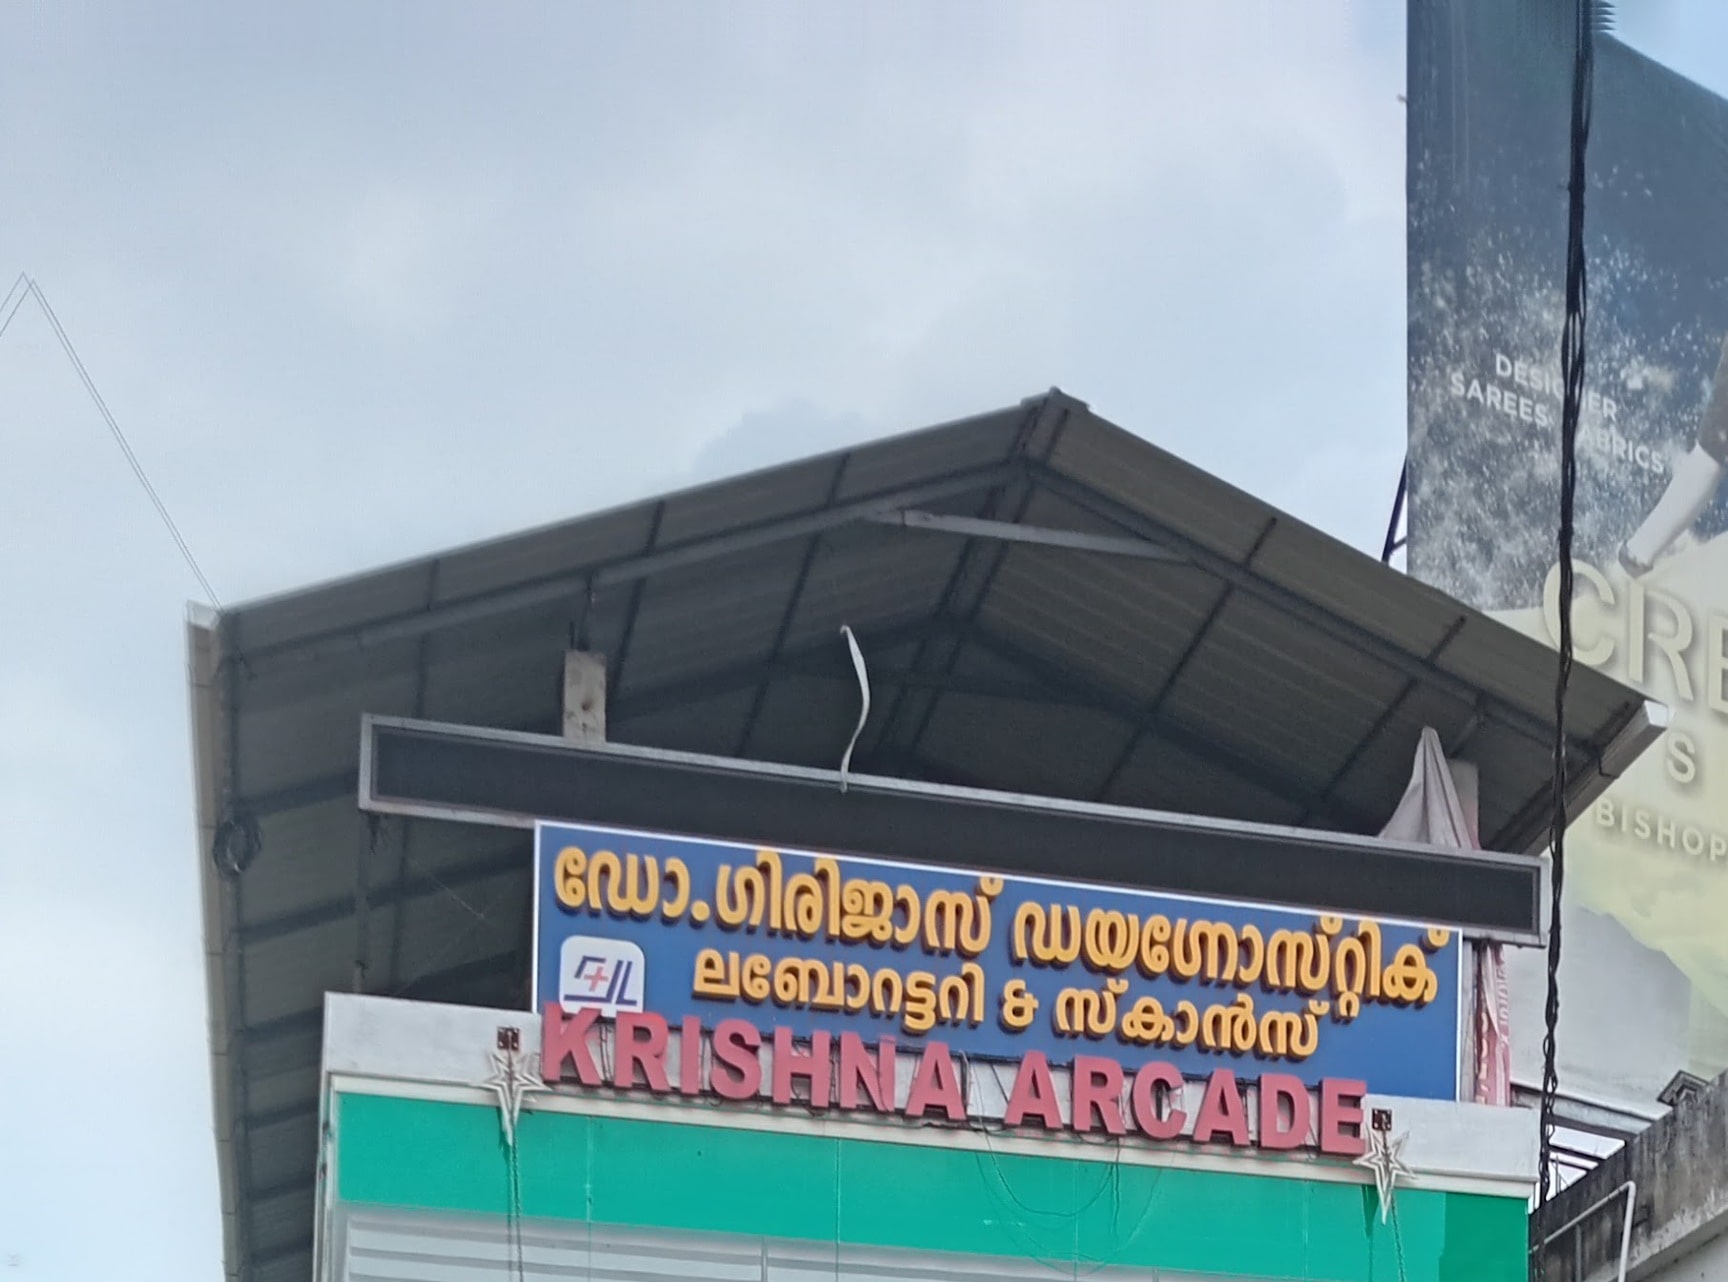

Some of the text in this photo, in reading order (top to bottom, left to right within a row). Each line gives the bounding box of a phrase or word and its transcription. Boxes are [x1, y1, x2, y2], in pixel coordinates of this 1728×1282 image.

[1450, 371, 1664, 475] SAREES ABRICS
[1595, 798, 1728, 863] BISHOP
[693, 948, 1329, 1058] ലബോറട്ടറി & സ്കാൻസ്
[540, 1003, 969, 1124] KRISHNA
[1003, 1052, 1367, 1158] ARCADE
